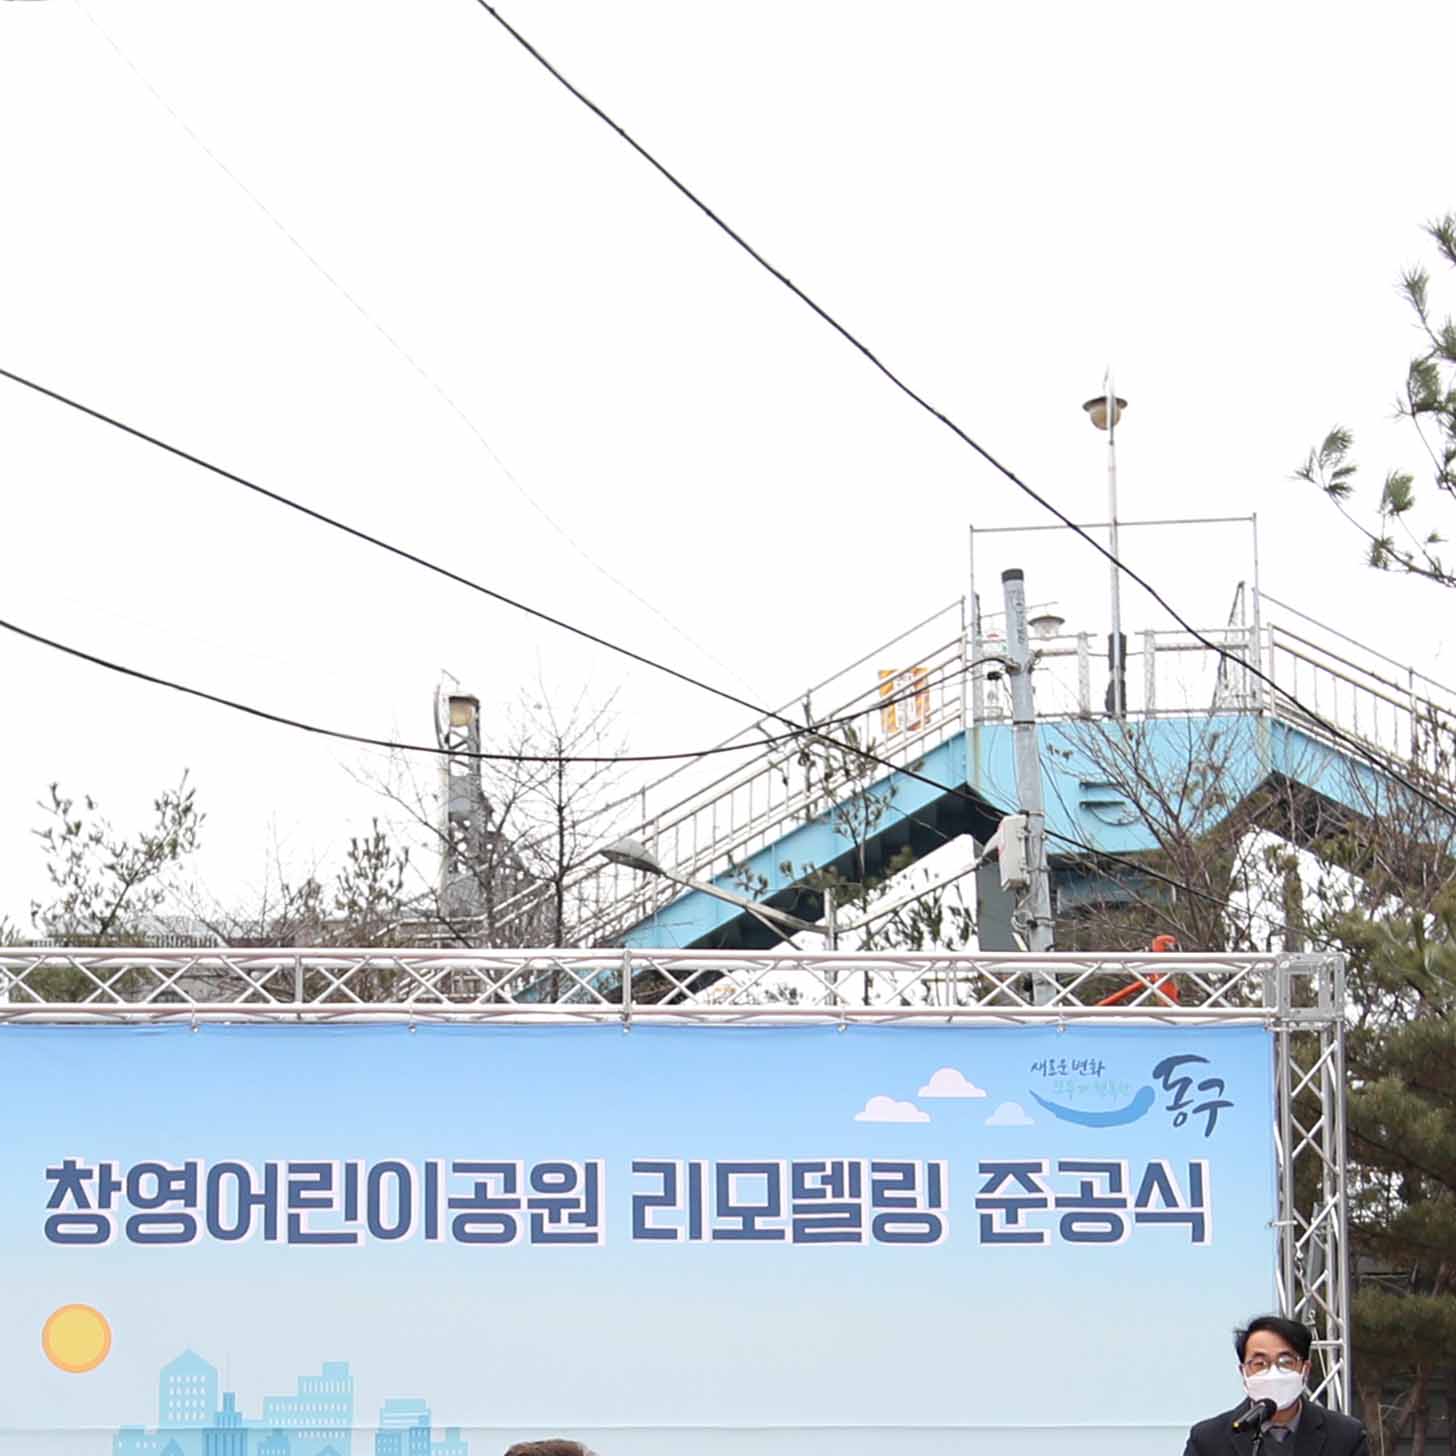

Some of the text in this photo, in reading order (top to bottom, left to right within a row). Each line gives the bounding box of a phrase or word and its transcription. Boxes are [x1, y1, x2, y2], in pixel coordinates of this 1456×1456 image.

[1030, 1058, 1106, 1077] 새로운 변화
[1151, 1053, 1235, 1138] 동구
[44, 1159, 1207, 1245] 창영어린이공원 리모델링 준공식
